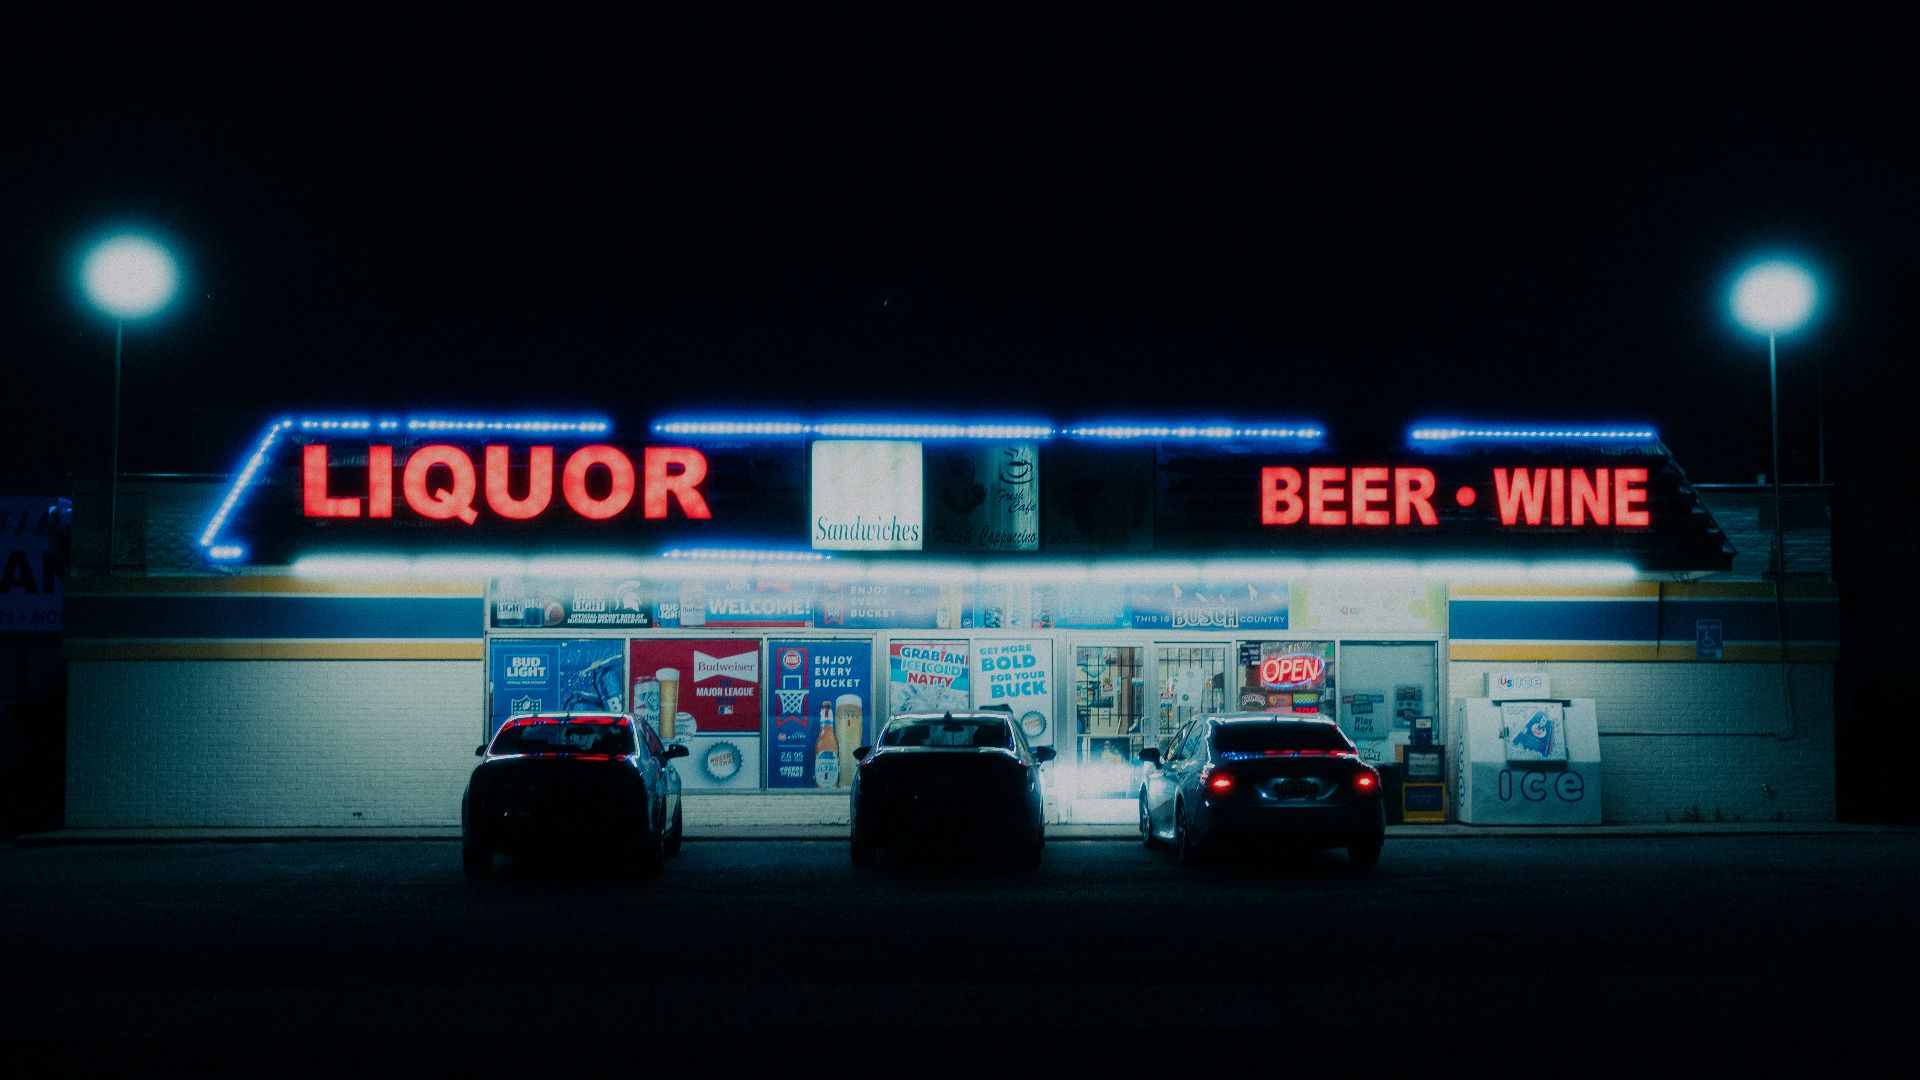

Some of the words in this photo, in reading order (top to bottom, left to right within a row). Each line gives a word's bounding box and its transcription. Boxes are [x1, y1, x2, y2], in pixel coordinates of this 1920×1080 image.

[303, 444, 712, 526] LIQUOR
[998, 488, 1024, 503] Fresh
[1261, 467, 1439, 526] BEER
[1493, 467, 1650, 526] WINE
[1008, 501, 1037, 514] Cafe
[815, 515, 920, 543] Sandwiches
[979, 523, 1037, 547] Cappuccino
[850, 586, 888, 595] ENJOY
[709, 600, 811, 615] WELCOME!
[850, 608, 896, 618] BUCKET
[1135, 615, 1158, 623] THIS
[1160, 615, 1170, 623] IS
[1172, 607, 1239, 628] BUSCH
[1239, 616, 1286, 624] COUNTRY
[901, 646, 942, 662] GRAB
[944, 652, 966, 665] AN
[979, 646, 1000, 656] GET
[1001, 644, 1032, 654] MORE
[512, 656, 541, 667] BUD
[697, 661, 755, 672] Budweiser
[814, 655, 853, 665] ENJOY
[981, 654, 1037, 672] BOLD
[506, 667, 547, 678] LIGHT
[814, 667, 852, 676] EVERY
[901, 659, 923, 672] ICE
[924, 661, 962, 677] COLD
[1262, 658, 1320, 682] OPEN
[814, 678, 861, 688] BUCKET
[908, 672, 955, 688] NATTY
[990, 673, 1012, 682] FOR
[1015, 671, 1045, 680] YOUR
[696, 687, 723, 697] MAJOR
[724, 687, 754, 697] LEAGUE
[991, 681, 1047, 699] BUCK
